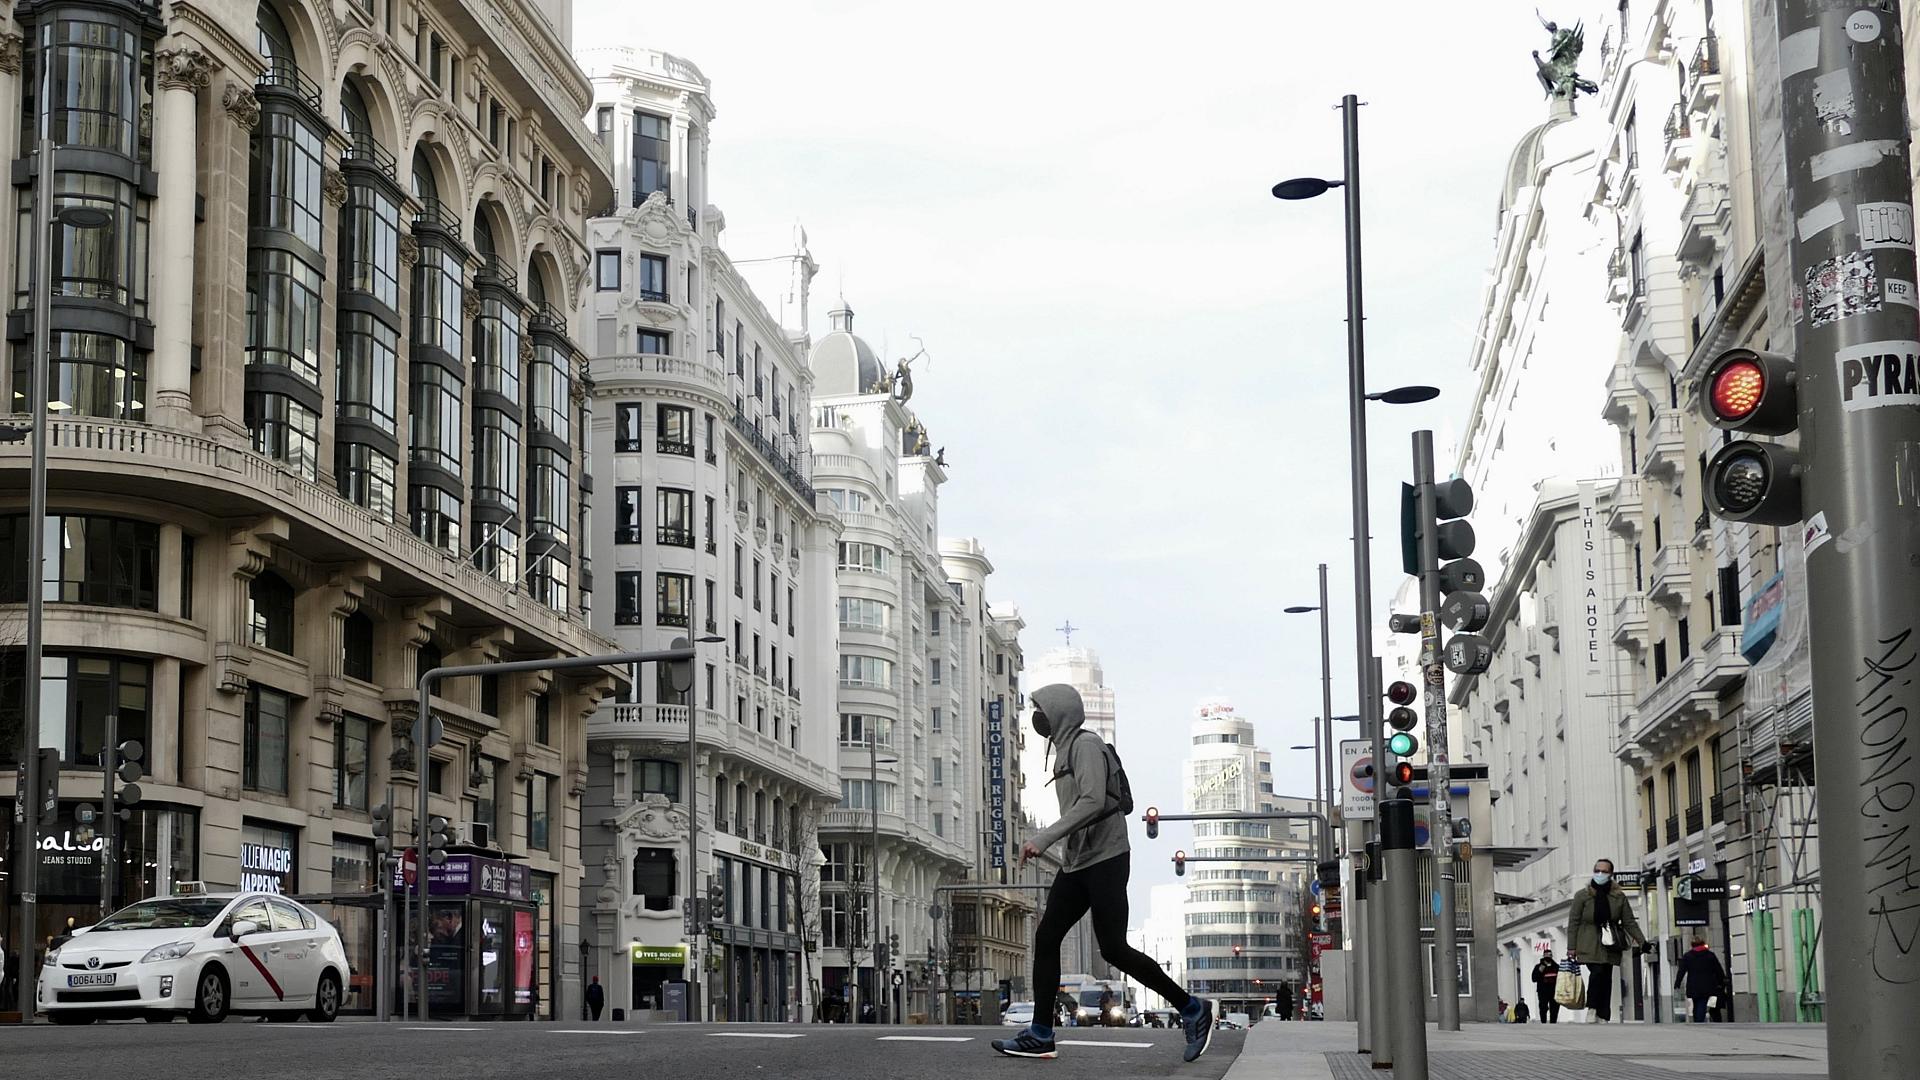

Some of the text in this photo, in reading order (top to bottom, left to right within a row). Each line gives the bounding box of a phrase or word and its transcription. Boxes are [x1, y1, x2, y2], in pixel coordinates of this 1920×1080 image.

[1887, 282, 1907, 295] KEEP
[1583, 507, 1594, 551] THIS
[1586, 558, 1595, 581] IS
[1586, 588, 1596, 597] A
[1586, 605, 1598, 662] HOTEL
[1190, 758, 1243, 802] hweppes
[990, 722, 1003, 867] HOTEL REGENTE
[42, 855, 92, 865] JEANS STUDIO
[492, 866, 507, 881] TACO
[180, 885, 193, 894] TAXI
[492, 880, 507, 894] BELL
[73, 974, 113, 985] 0064 HJD
